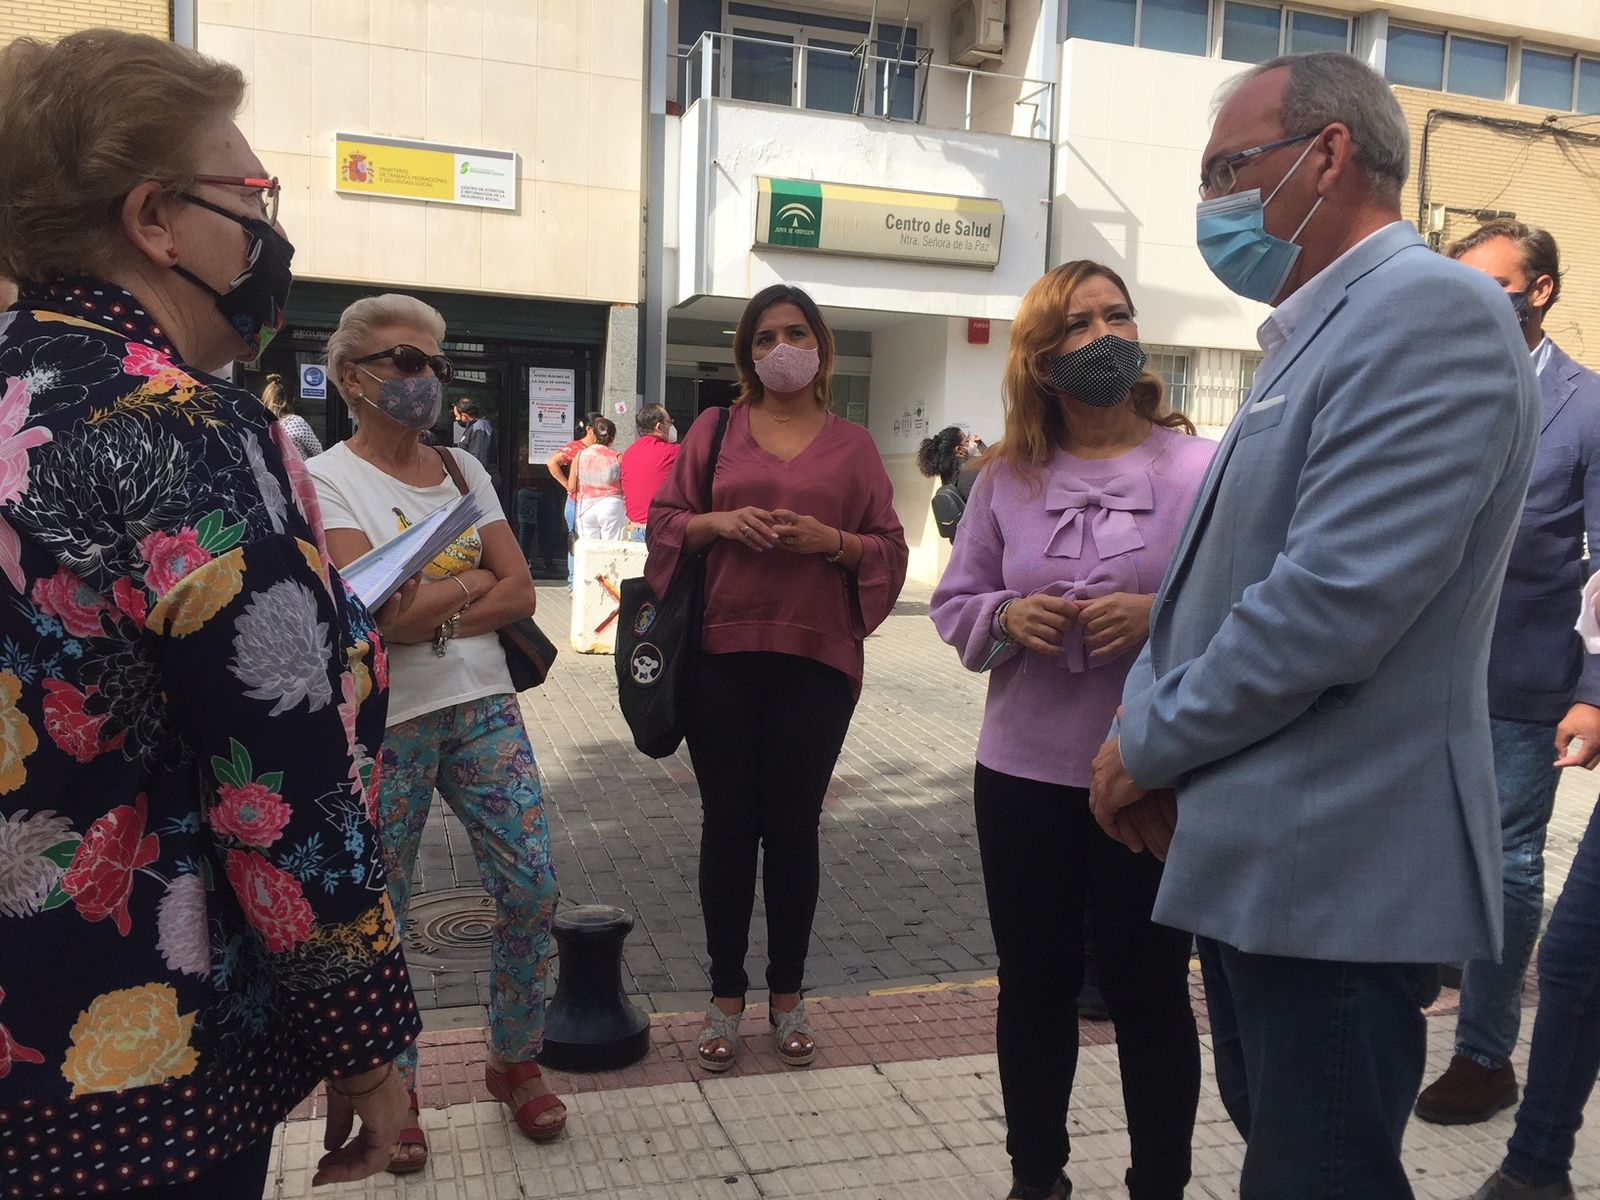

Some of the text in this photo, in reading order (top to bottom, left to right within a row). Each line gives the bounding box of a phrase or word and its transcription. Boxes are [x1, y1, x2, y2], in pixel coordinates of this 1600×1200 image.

[774, 226, 787, 234] JUNTA
[885, 213, 992, 238] Centro de Salud
[900, 233, 989, 252] Ntra. Señora de la Paz
